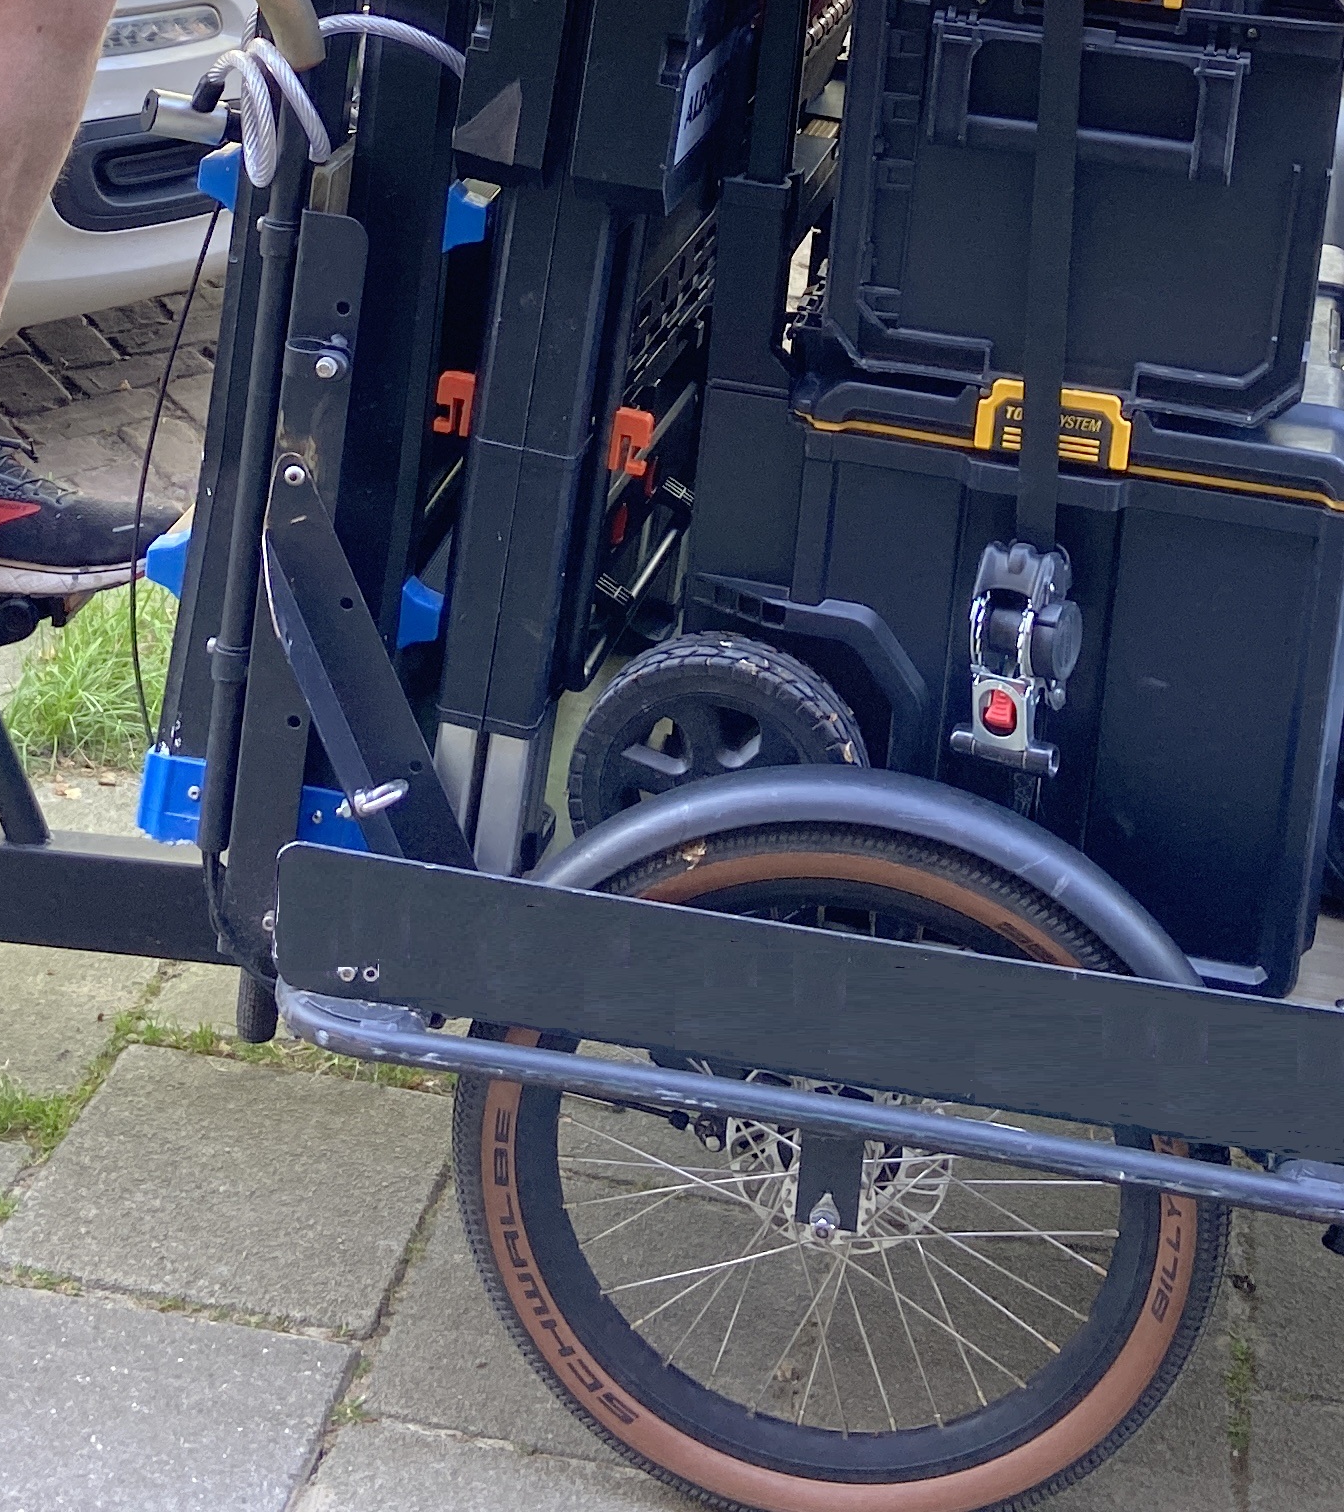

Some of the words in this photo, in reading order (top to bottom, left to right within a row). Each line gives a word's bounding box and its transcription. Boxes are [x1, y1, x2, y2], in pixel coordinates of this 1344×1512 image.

[1005, 405, 1103, 433] TOYSTEM
[493, 1106, 641, 1428] SCHWALBE
[1151, 1195, 1183, 1324] BILLY
